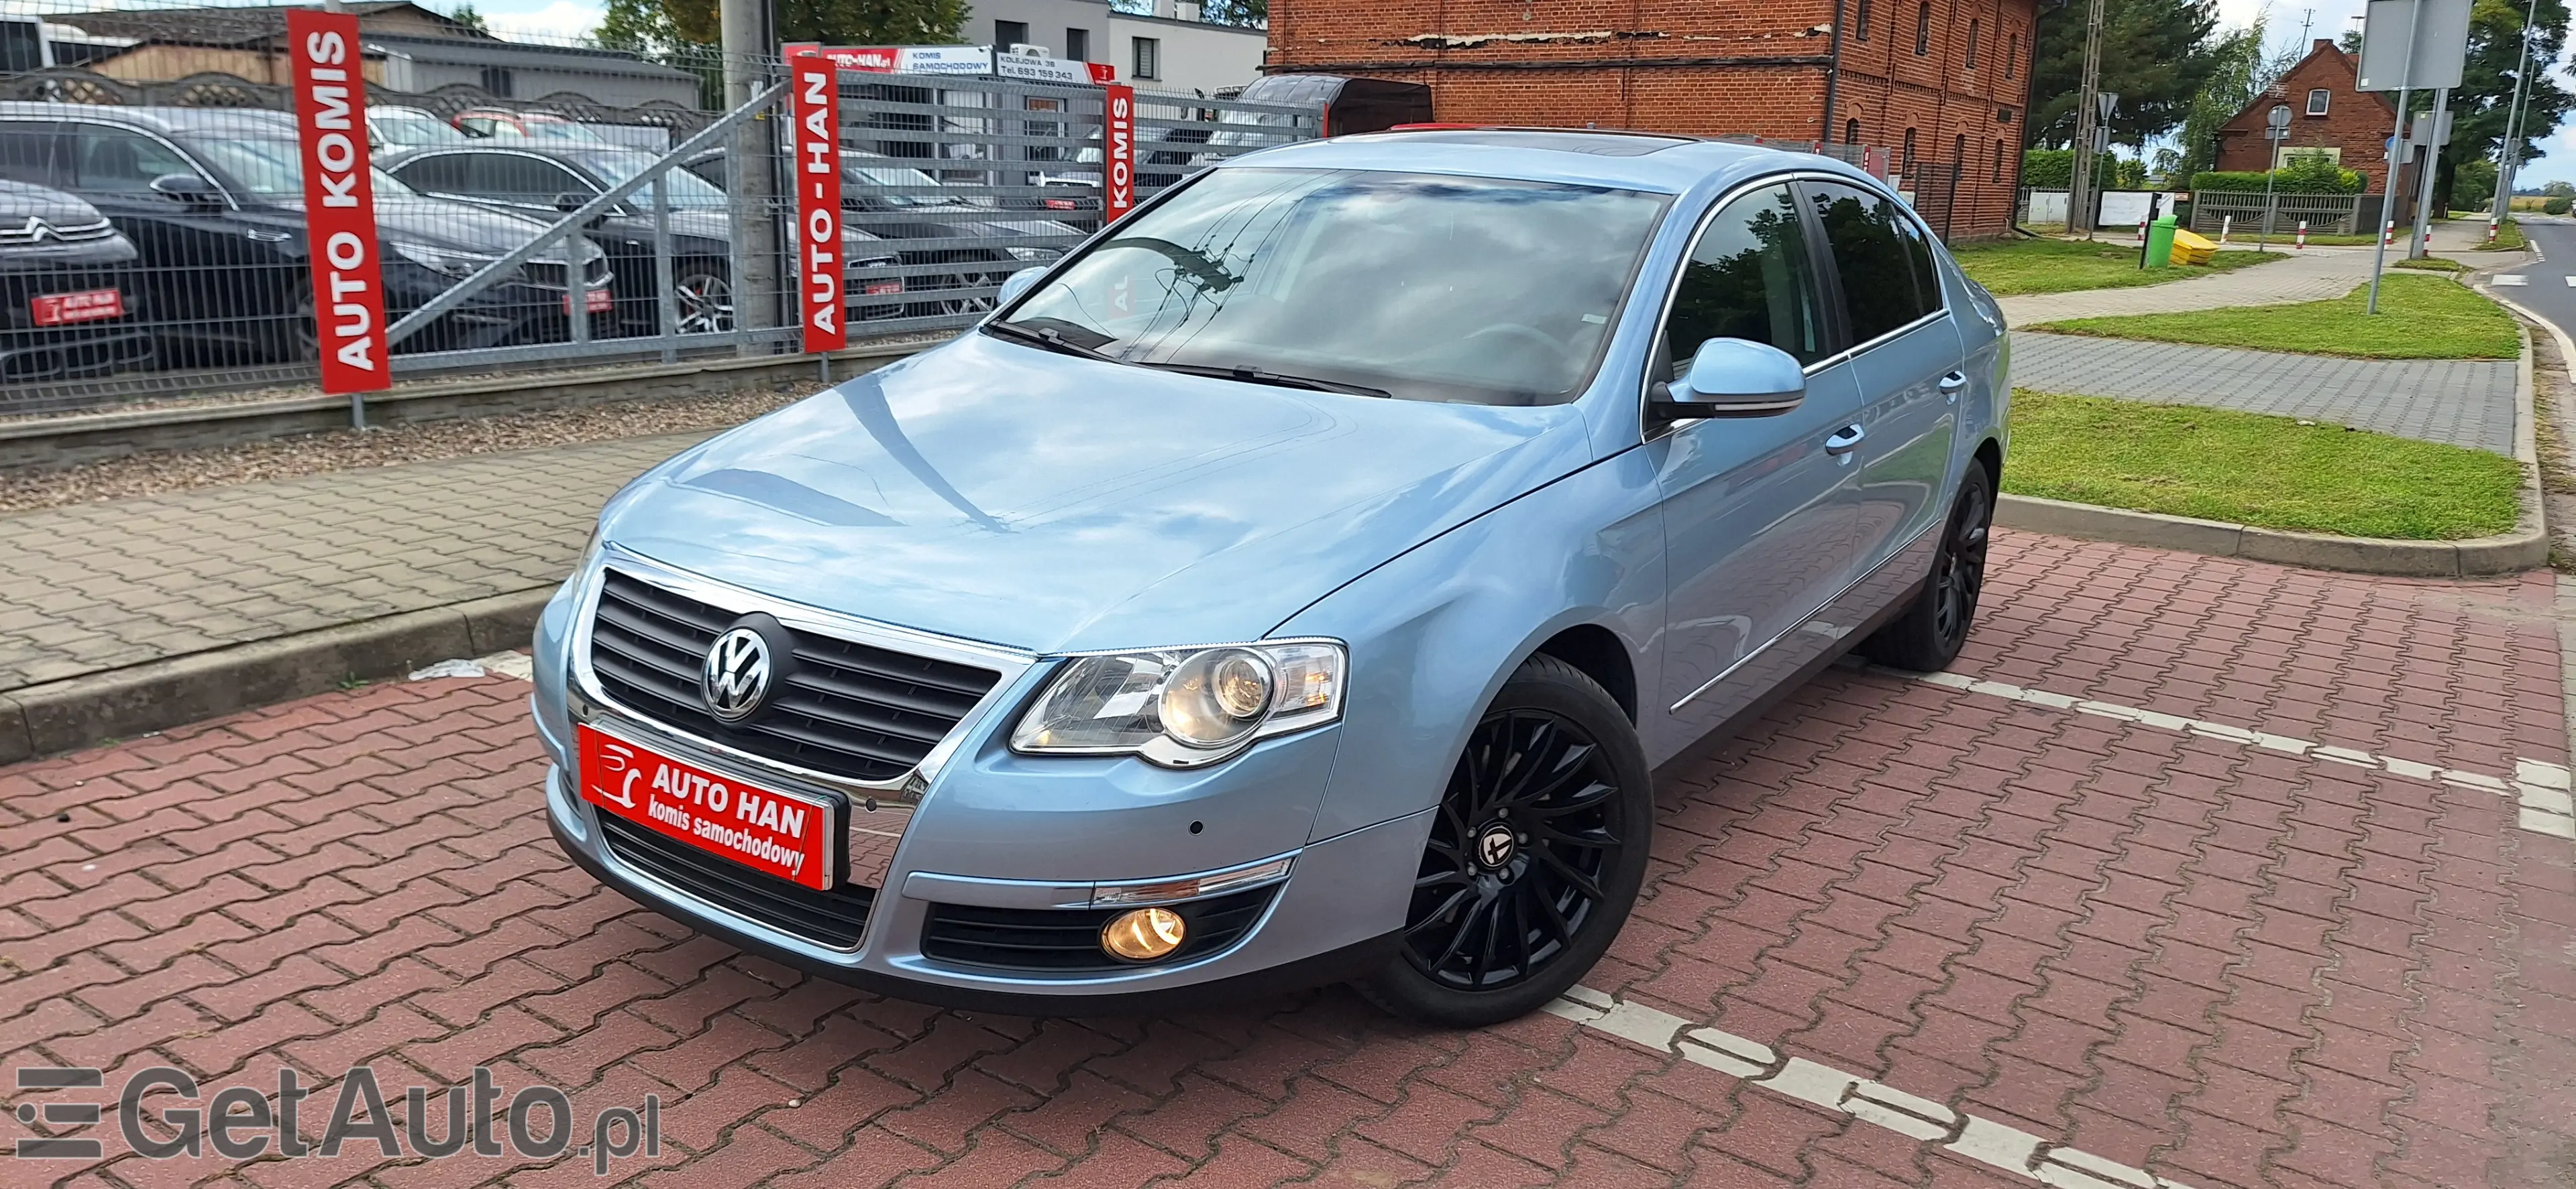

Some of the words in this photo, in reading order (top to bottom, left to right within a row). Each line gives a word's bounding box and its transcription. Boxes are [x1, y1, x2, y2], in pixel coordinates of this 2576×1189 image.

[912, 62, 988, 70] SAMOCHODOWY
[1017, 68, 1036, 76] 693
[1038, 69, 1053, 78] 159
[1055, 71, 1073, 80] 343
[306, 30, 359, 208] KOMIS
[1113, 97, 1128, 209] KOMIS
[804, 72, 836, 335] AUTO-HAN
[325, 230, 375, 372] AUTO
[648, 793, 690, 830] komis
[693, 817, 805, 876] samochodowy
[651, 763, 729, 812] AUTO
[737, 791, 805, 838] HAN
